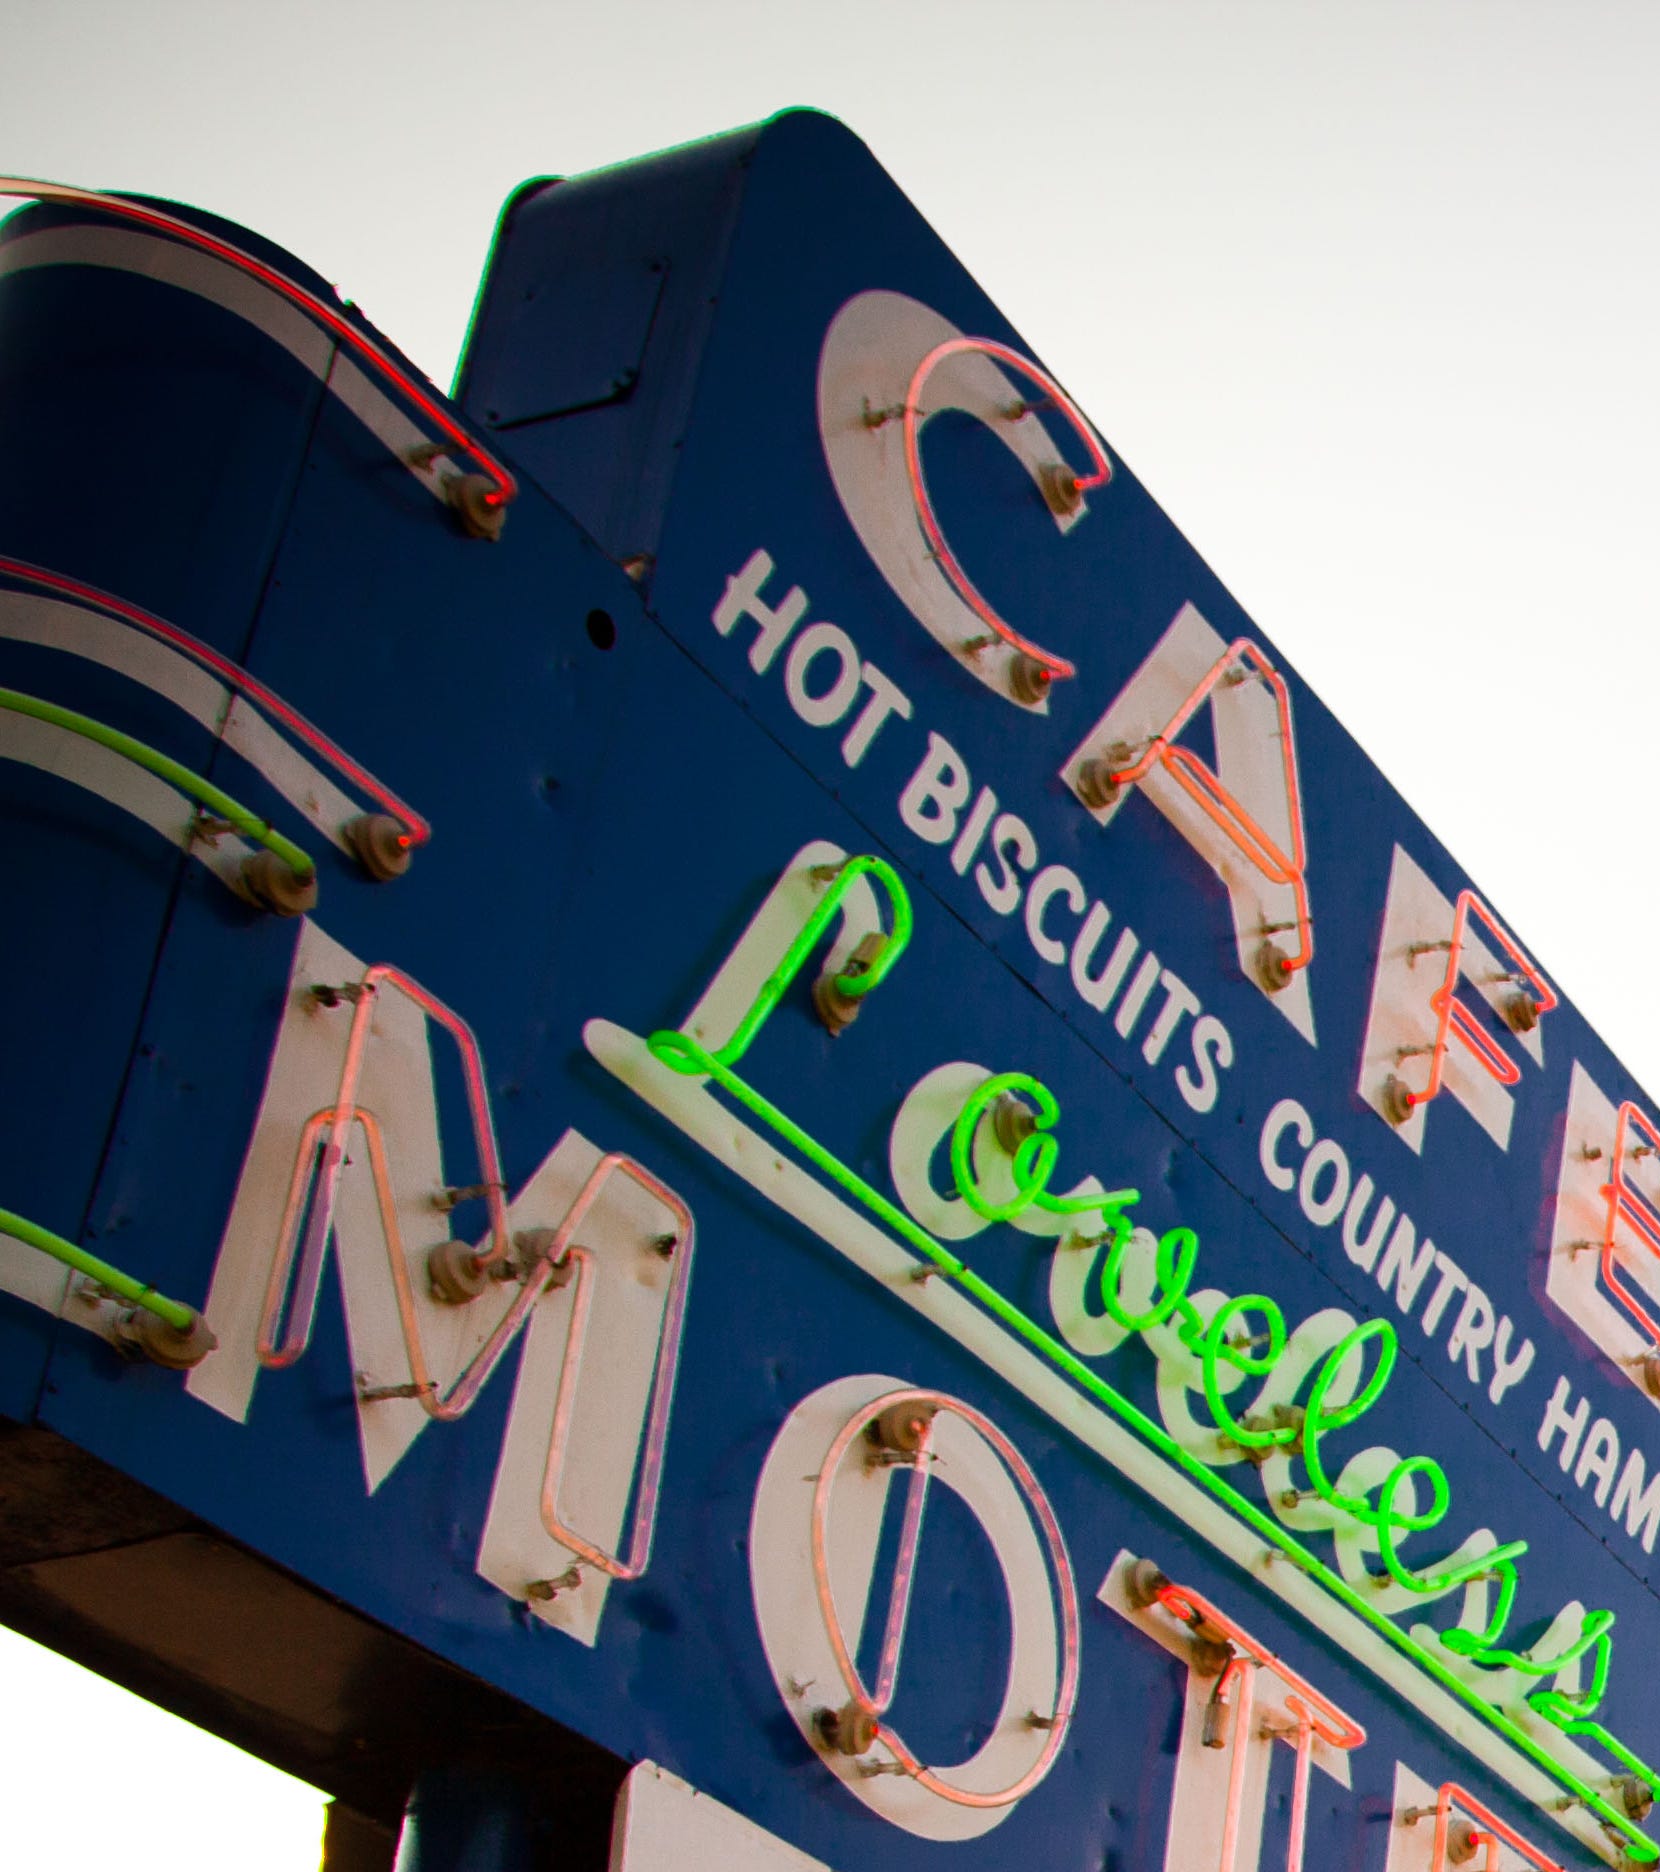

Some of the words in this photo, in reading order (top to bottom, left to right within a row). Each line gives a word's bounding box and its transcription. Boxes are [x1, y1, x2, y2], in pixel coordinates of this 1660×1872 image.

[710, 549, 912, 770] HOT
[898, 730, 1236, 1114] BISCUITS
[1258, 1097, 1536, 1410] COUNTRY
